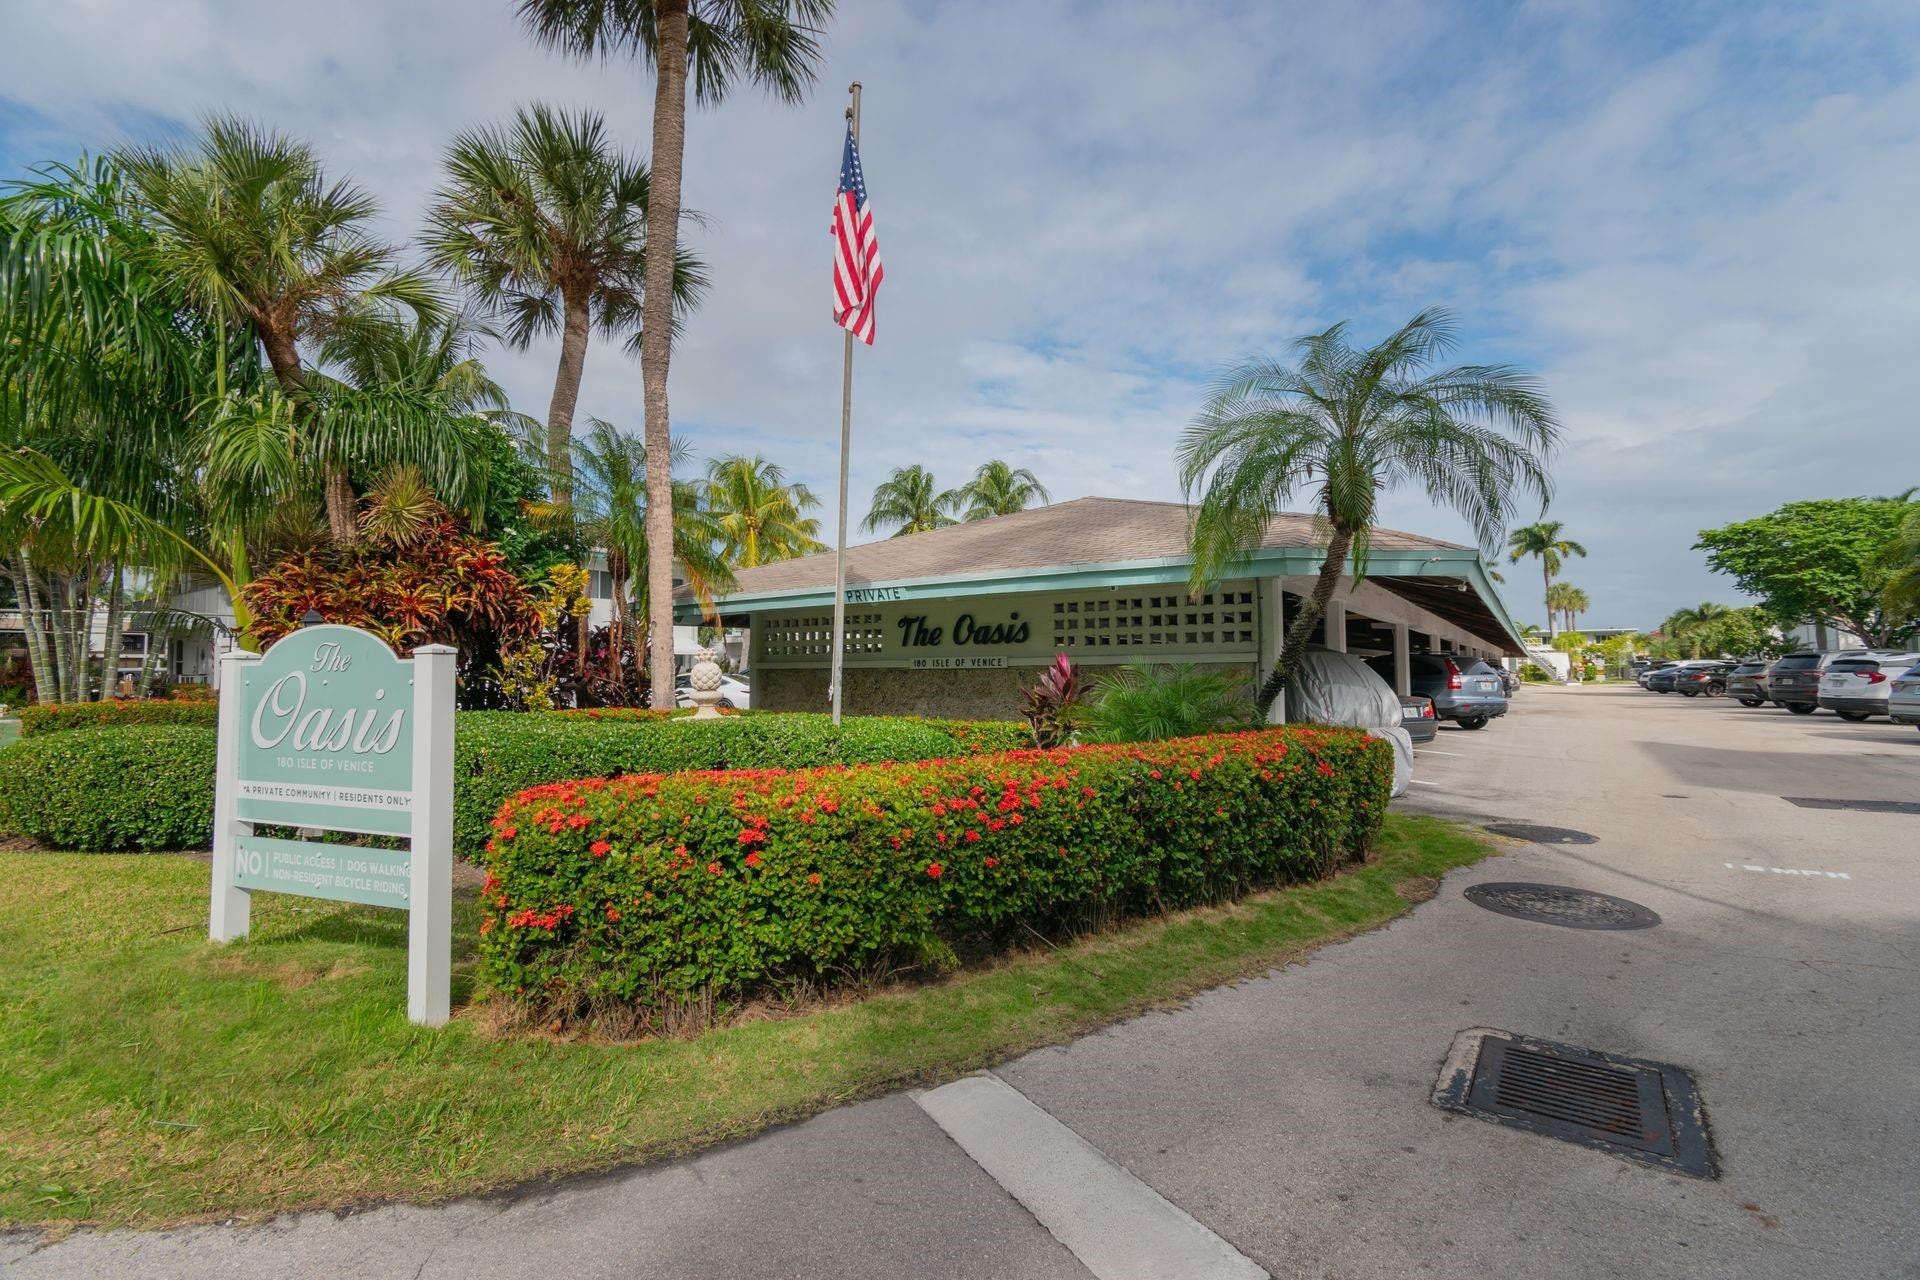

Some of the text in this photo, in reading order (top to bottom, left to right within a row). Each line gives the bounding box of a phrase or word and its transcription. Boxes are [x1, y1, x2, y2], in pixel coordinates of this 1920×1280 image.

[846, 588, 901, 603] PRIVATE
[898, 611, 1030, 647] The Oasis
[310, 640, 352, 673] The
[913, 658, 1003, 668] 180 ISLE OF VENICE
[251, 670, 405, 754] Oasis
[276, 756, 375, 773] 180 ISLE OF VENICE
[252, 786, 283, 797] PRIVATE
[285, 788, 331, 800] COMMUNITY
[339, 792, 383, 804] RESIDENTS
[386, 795, 410, 806] ONLY
[235, 849, 262, 875] NO
[273, 852, 411, 878] PUBLIC ACCESS DOG WALKING
[273, 867, 334, 887] NON-RESIDENT
[335, 875, 372, 891] BICYCLE
